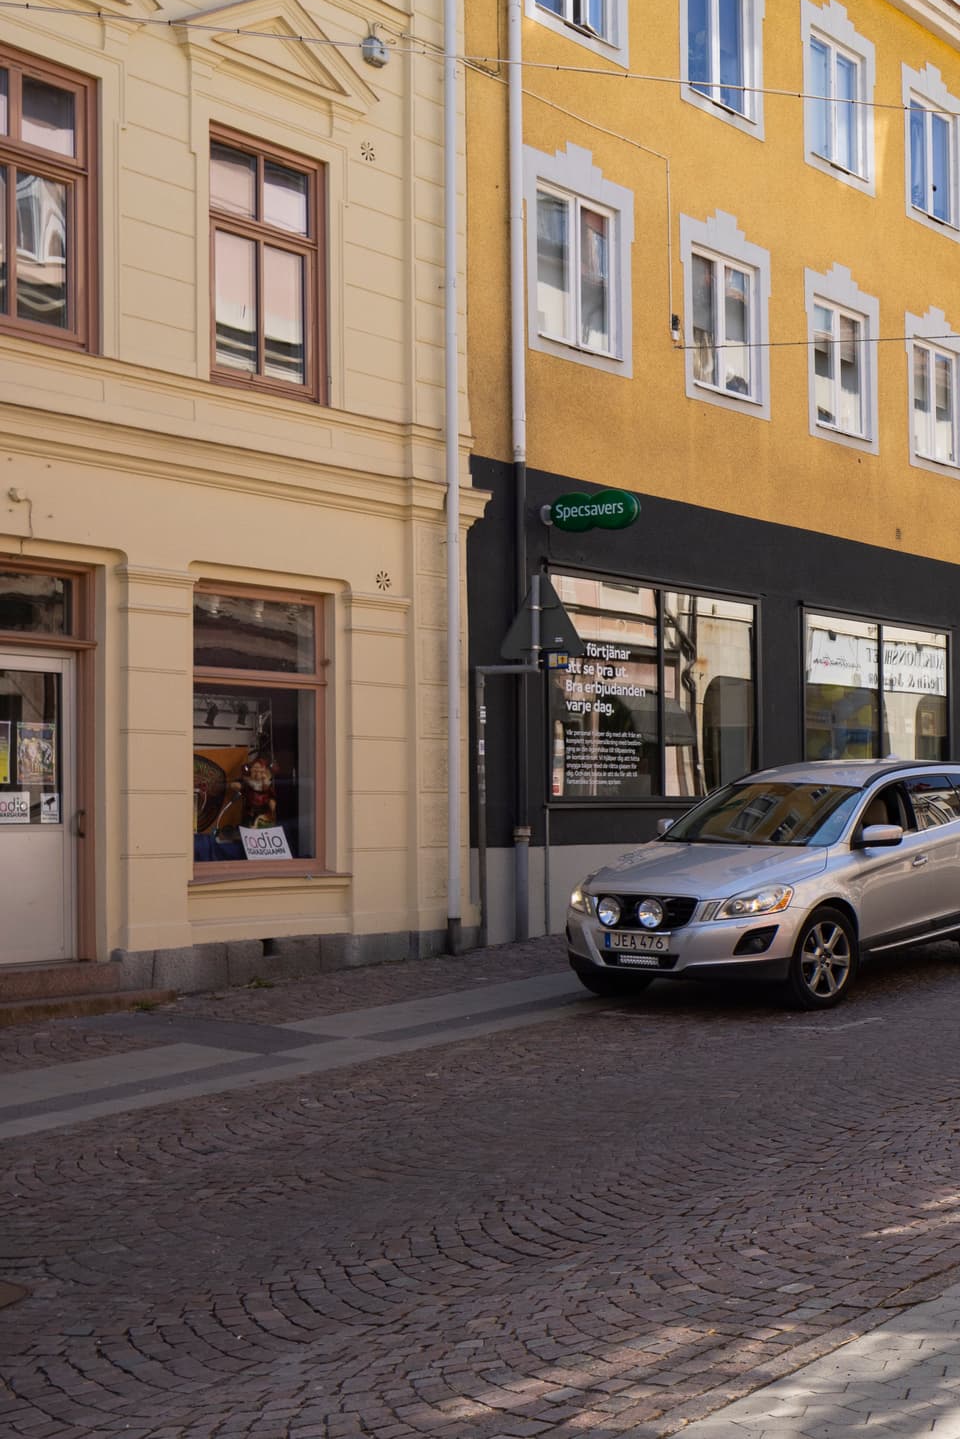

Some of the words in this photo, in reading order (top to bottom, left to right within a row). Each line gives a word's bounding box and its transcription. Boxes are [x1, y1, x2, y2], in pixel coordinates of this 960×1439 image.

[555, 502, 624, 522] Specsavers
[586, 642, 631, 660] förtjänar
[566, 660, 582, 674] att
[583, 665, 596, 675] se
[596, 663, 613, 677] bra
[615, 666, 628, 678] ut.
[565, 679, 583, 693] Bra
[585, 680, 646, 698] erbjudanden
[566, 700, 592, 714] varje
[594, 700, 615, 716] dag.
[244, 832, 283, 849] radio
[614, 933, 637, 947] JEA
[640, 935, 664, 949] 476
